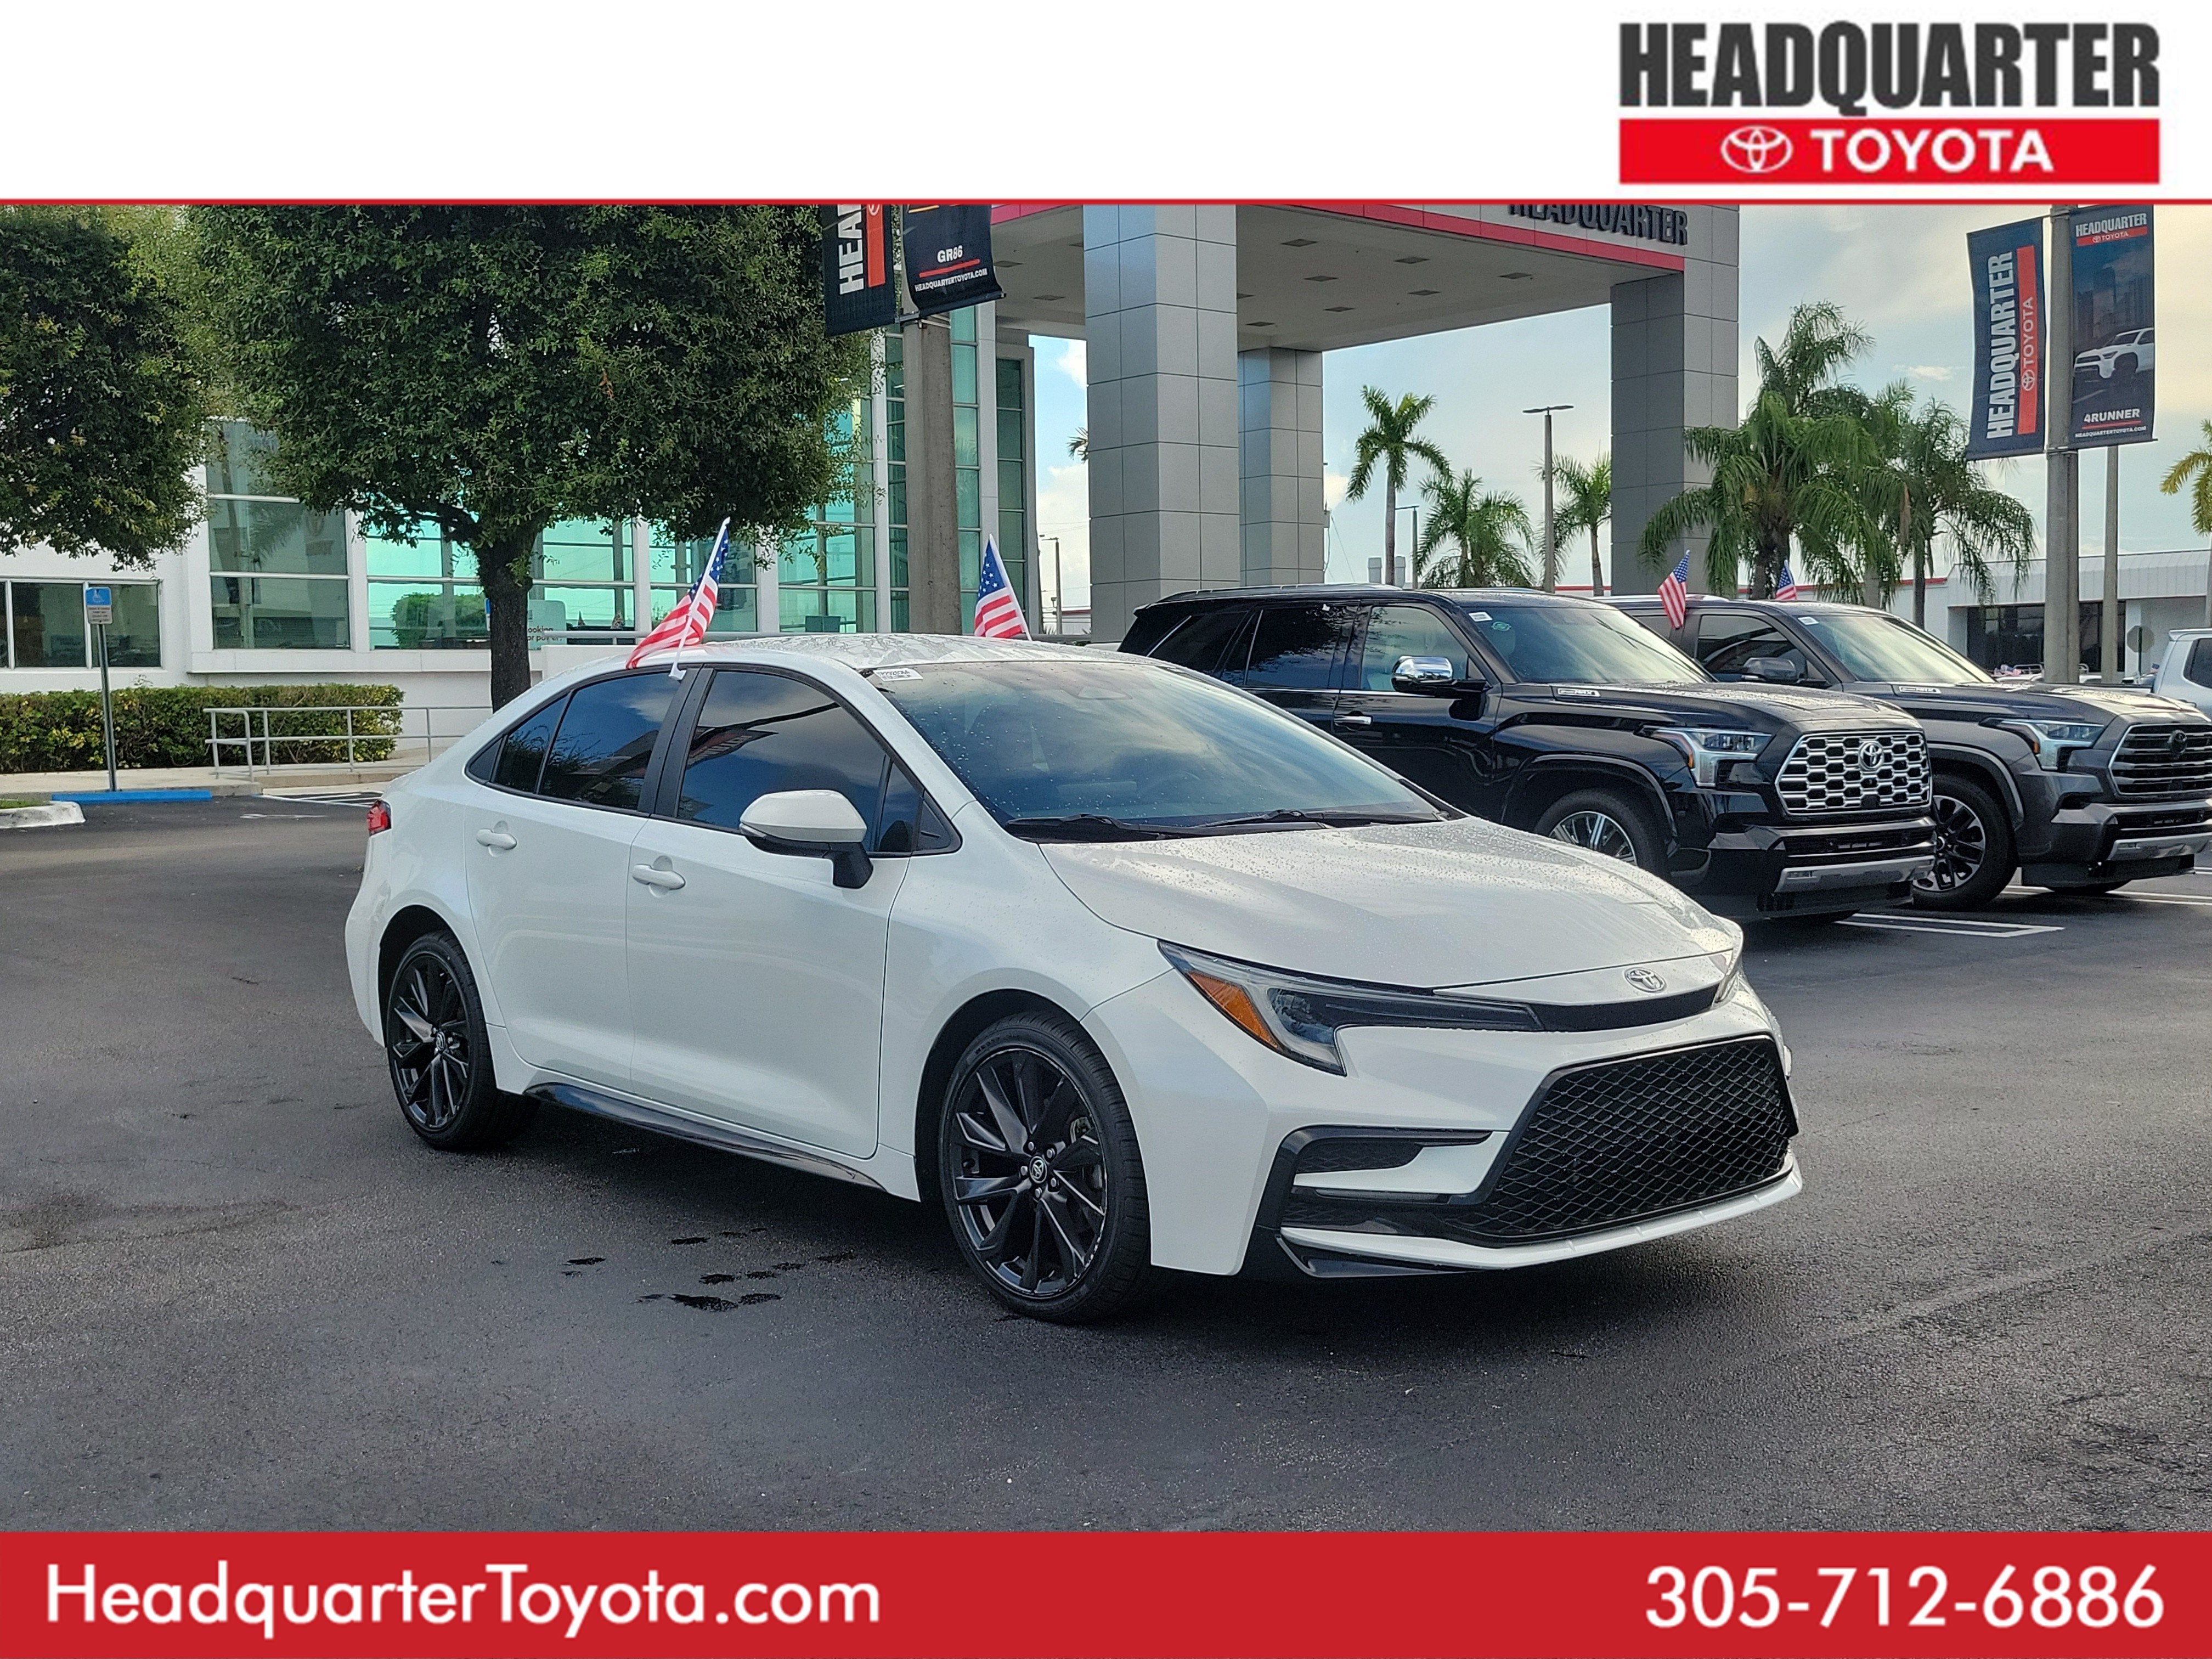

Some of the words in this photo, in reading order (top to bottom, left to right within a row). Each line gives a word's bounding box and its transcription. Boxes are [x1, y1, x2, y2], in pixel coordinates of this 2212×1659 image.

[2075, 212, 2148, 237] HEADQUARTER
[2101, 231, 2129, 241] TOYOTA
[937, 245, 963, 263] GR86
[914, 268, 988, 292] HEADQUARTERTOYOTA.COM
[2023, 296, 2034, 368] TOYOTA
[1987, 251, 2020, 439] HEADQUARTER
[2084, 408, 2140, 423] 4RUNNER
[2075, 426, 2146, 438] HEADQUARTERTOYOTA.COM
